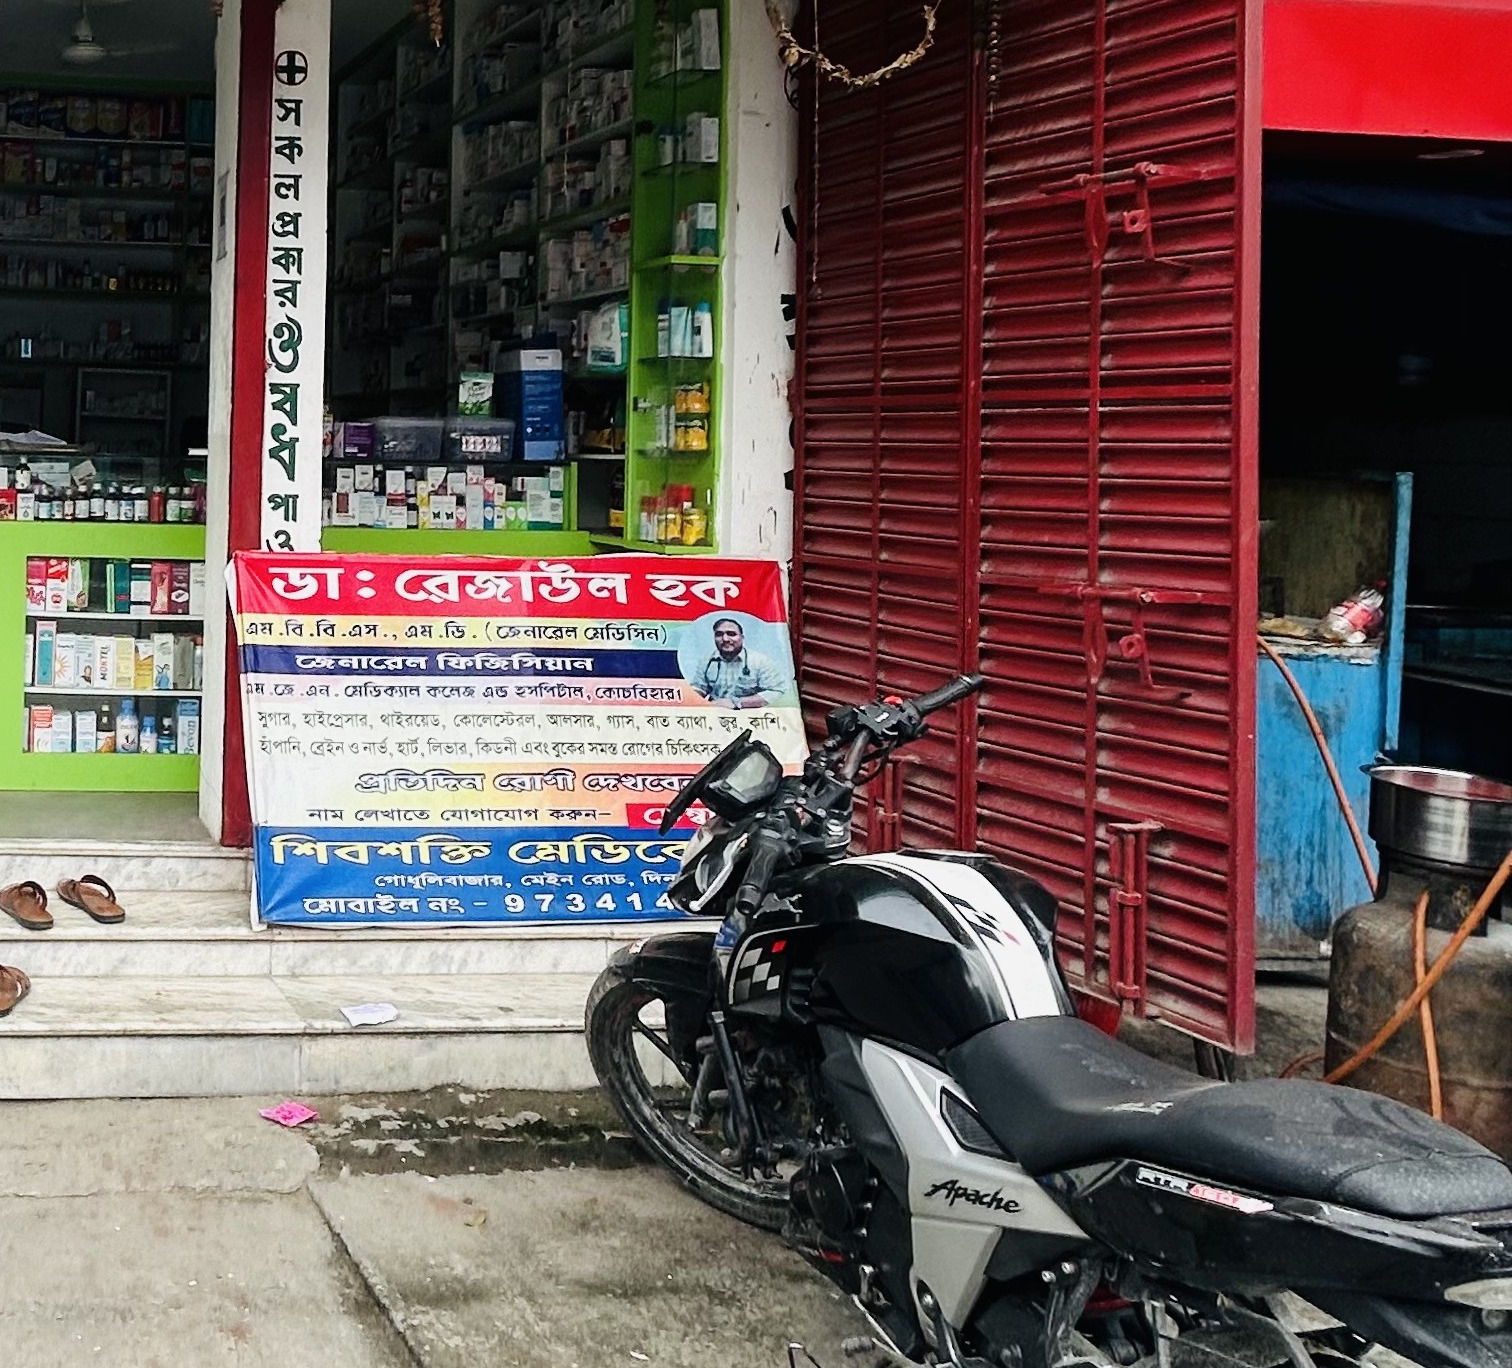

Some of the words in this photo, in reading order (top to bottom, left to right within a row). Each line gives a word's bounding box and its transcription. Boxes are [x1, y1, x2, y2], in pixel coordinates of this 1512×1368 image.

[273, 98, 304, 201] সকল
[395, 560, 632, 607] রেজাউল
[646, 574, 743, 609] হক
[583, 622, 668, 645] মেডিসিন)
[294, 653, 429, 672] জেনারেল
[436, 651, 595, 673] ফিজিসিয়ান
[646, 715, 670, 729] বাত
[748, 712, 788, 732] কাশি,
[349, 743, 360, 756] ও
[474, 737, 518, 757] কিডনী
[521, 741, 550, 756] এবং
[551, 742, 586, 759] বুকের
[621, 742, 664, 758] রোগের
[354, 768, 486, 794] প্রতিদিন
[492, 767, 578, 794] রোগী
[306, 806, 346, 822] নাম
[353, 806, 430, 823] লেখাতে
[440, 806, 539, 823] যোগাযোগ
[270, 832, 492, 867] শিবশক্তি
[518, 870, 574, 888] মেইন
[301, 891, 421, 916] মোবাইল
[426, 896, 465, 915] নং
[502, 893, 676, 913] 973414
[923, 1178, 1024, 1215] Apache
